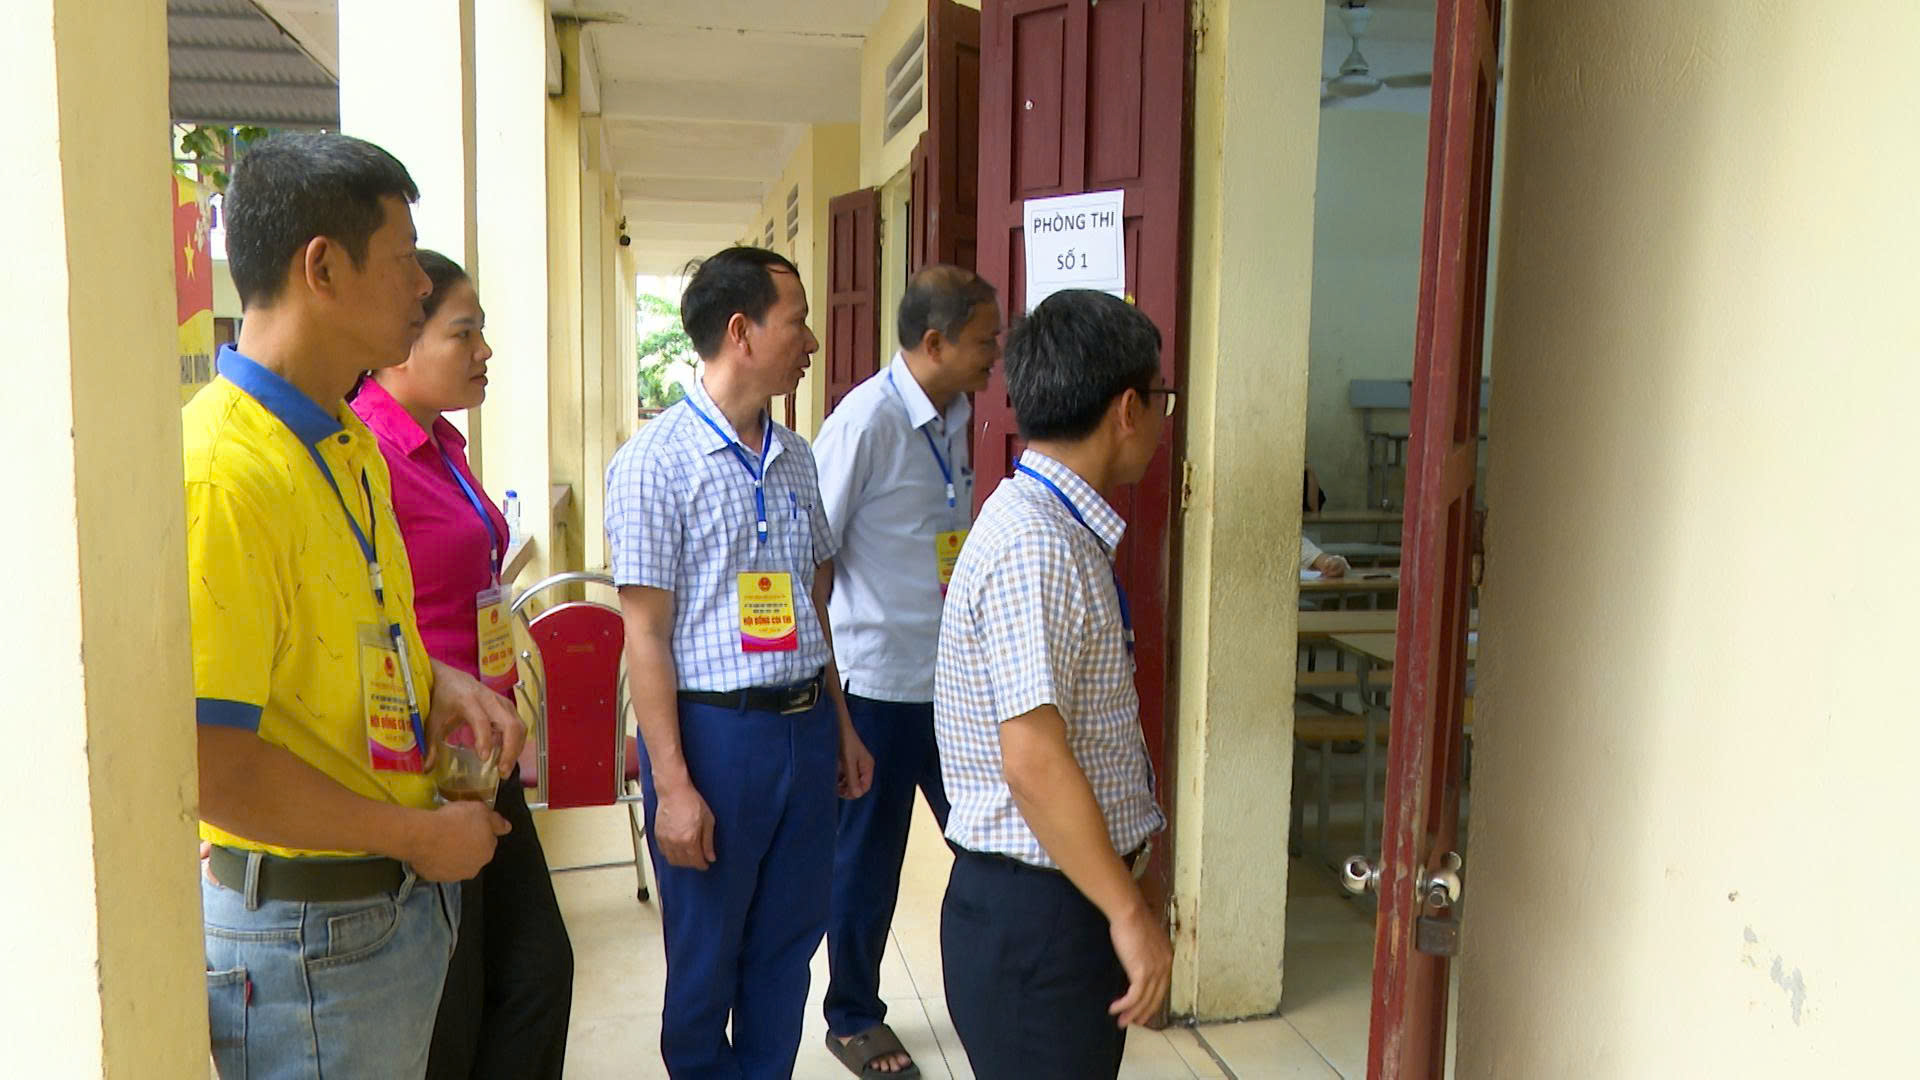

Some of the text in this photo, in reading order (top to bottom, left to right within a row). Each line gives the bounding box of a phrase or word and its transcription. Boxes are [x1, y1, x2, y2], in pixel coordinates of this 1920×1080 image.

[1033, 211, 1115, 234] PHÒNG THI
[1057, 247, 1088, 270] SỐ 1
